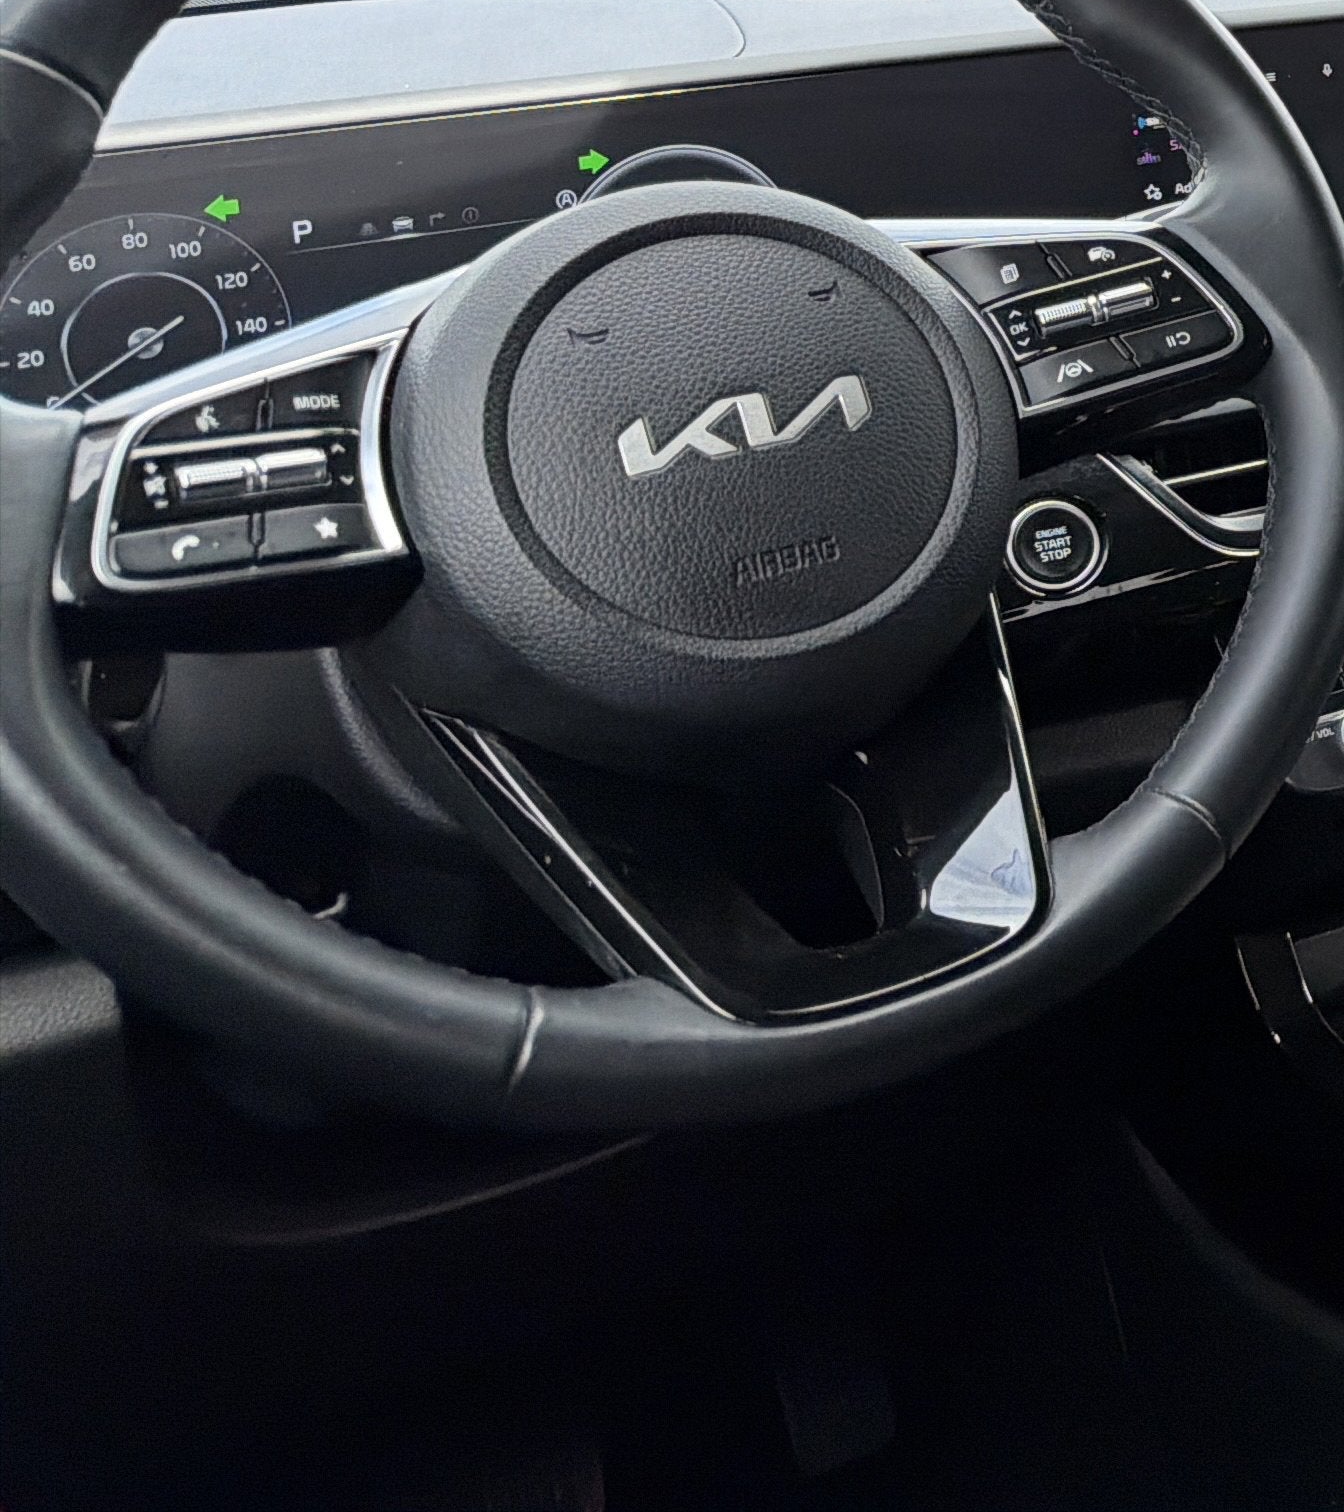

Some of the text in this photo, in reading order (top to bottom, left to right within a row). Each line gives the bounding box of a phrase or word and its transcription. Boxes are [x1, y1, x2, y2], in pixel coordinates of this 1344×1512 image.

[121, 231, 148, 251] 80
[292, 218, 313, 245] P
[168, 240, 202, 259] 100
[68, 253, 97, 273] 60
[215, 270, 249, 291] 120
[26, 298, 55, 317] 40
[235, 316, 268, 335] 140
[1010, 321, 1030, 336] OK
[16, 350, 45, 369] 20
[293, 393, 341, 411] MODE
[617, 374, 872, 479] KIA
[1035, 525, 1068, 539] ENGINE
[1034, 535, 1073, 552] START
[736, 535, 841, 588] AIRBAG
[1040, 547, 1072, 563] STOP
